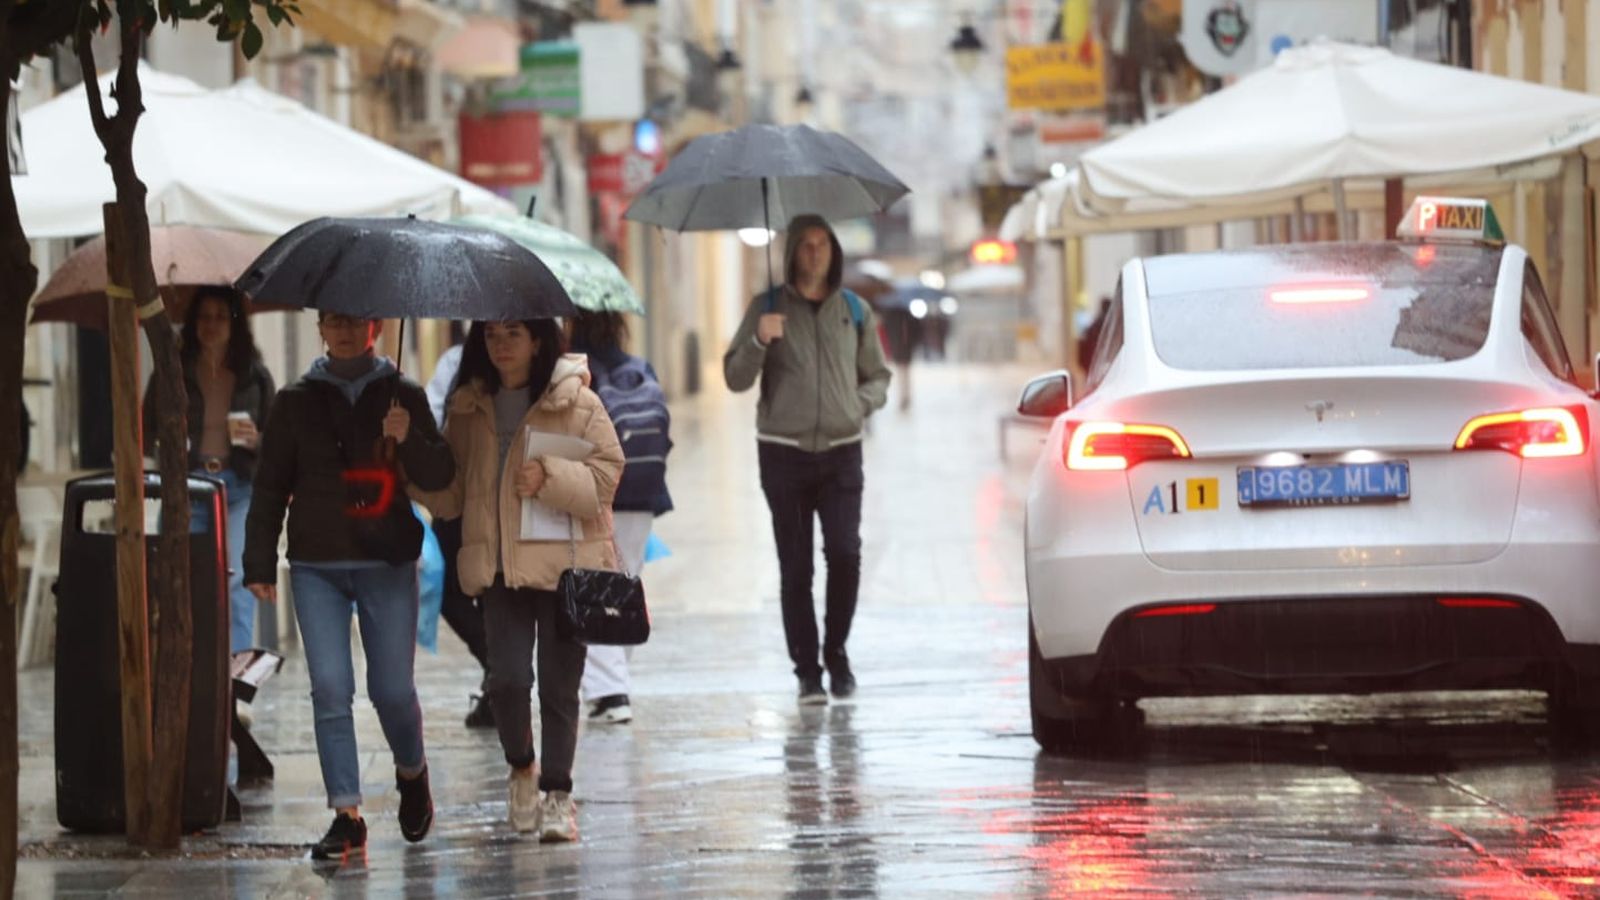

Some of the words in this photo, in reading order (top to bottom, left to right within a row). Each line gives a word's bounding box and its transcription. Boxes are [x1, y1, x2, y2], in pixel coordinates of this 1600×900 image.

[1438, 205, 1481, 229] TAXI
[1259, 469, 1333, 497] 9682
[1344, 466, 1401, 493] MLM
